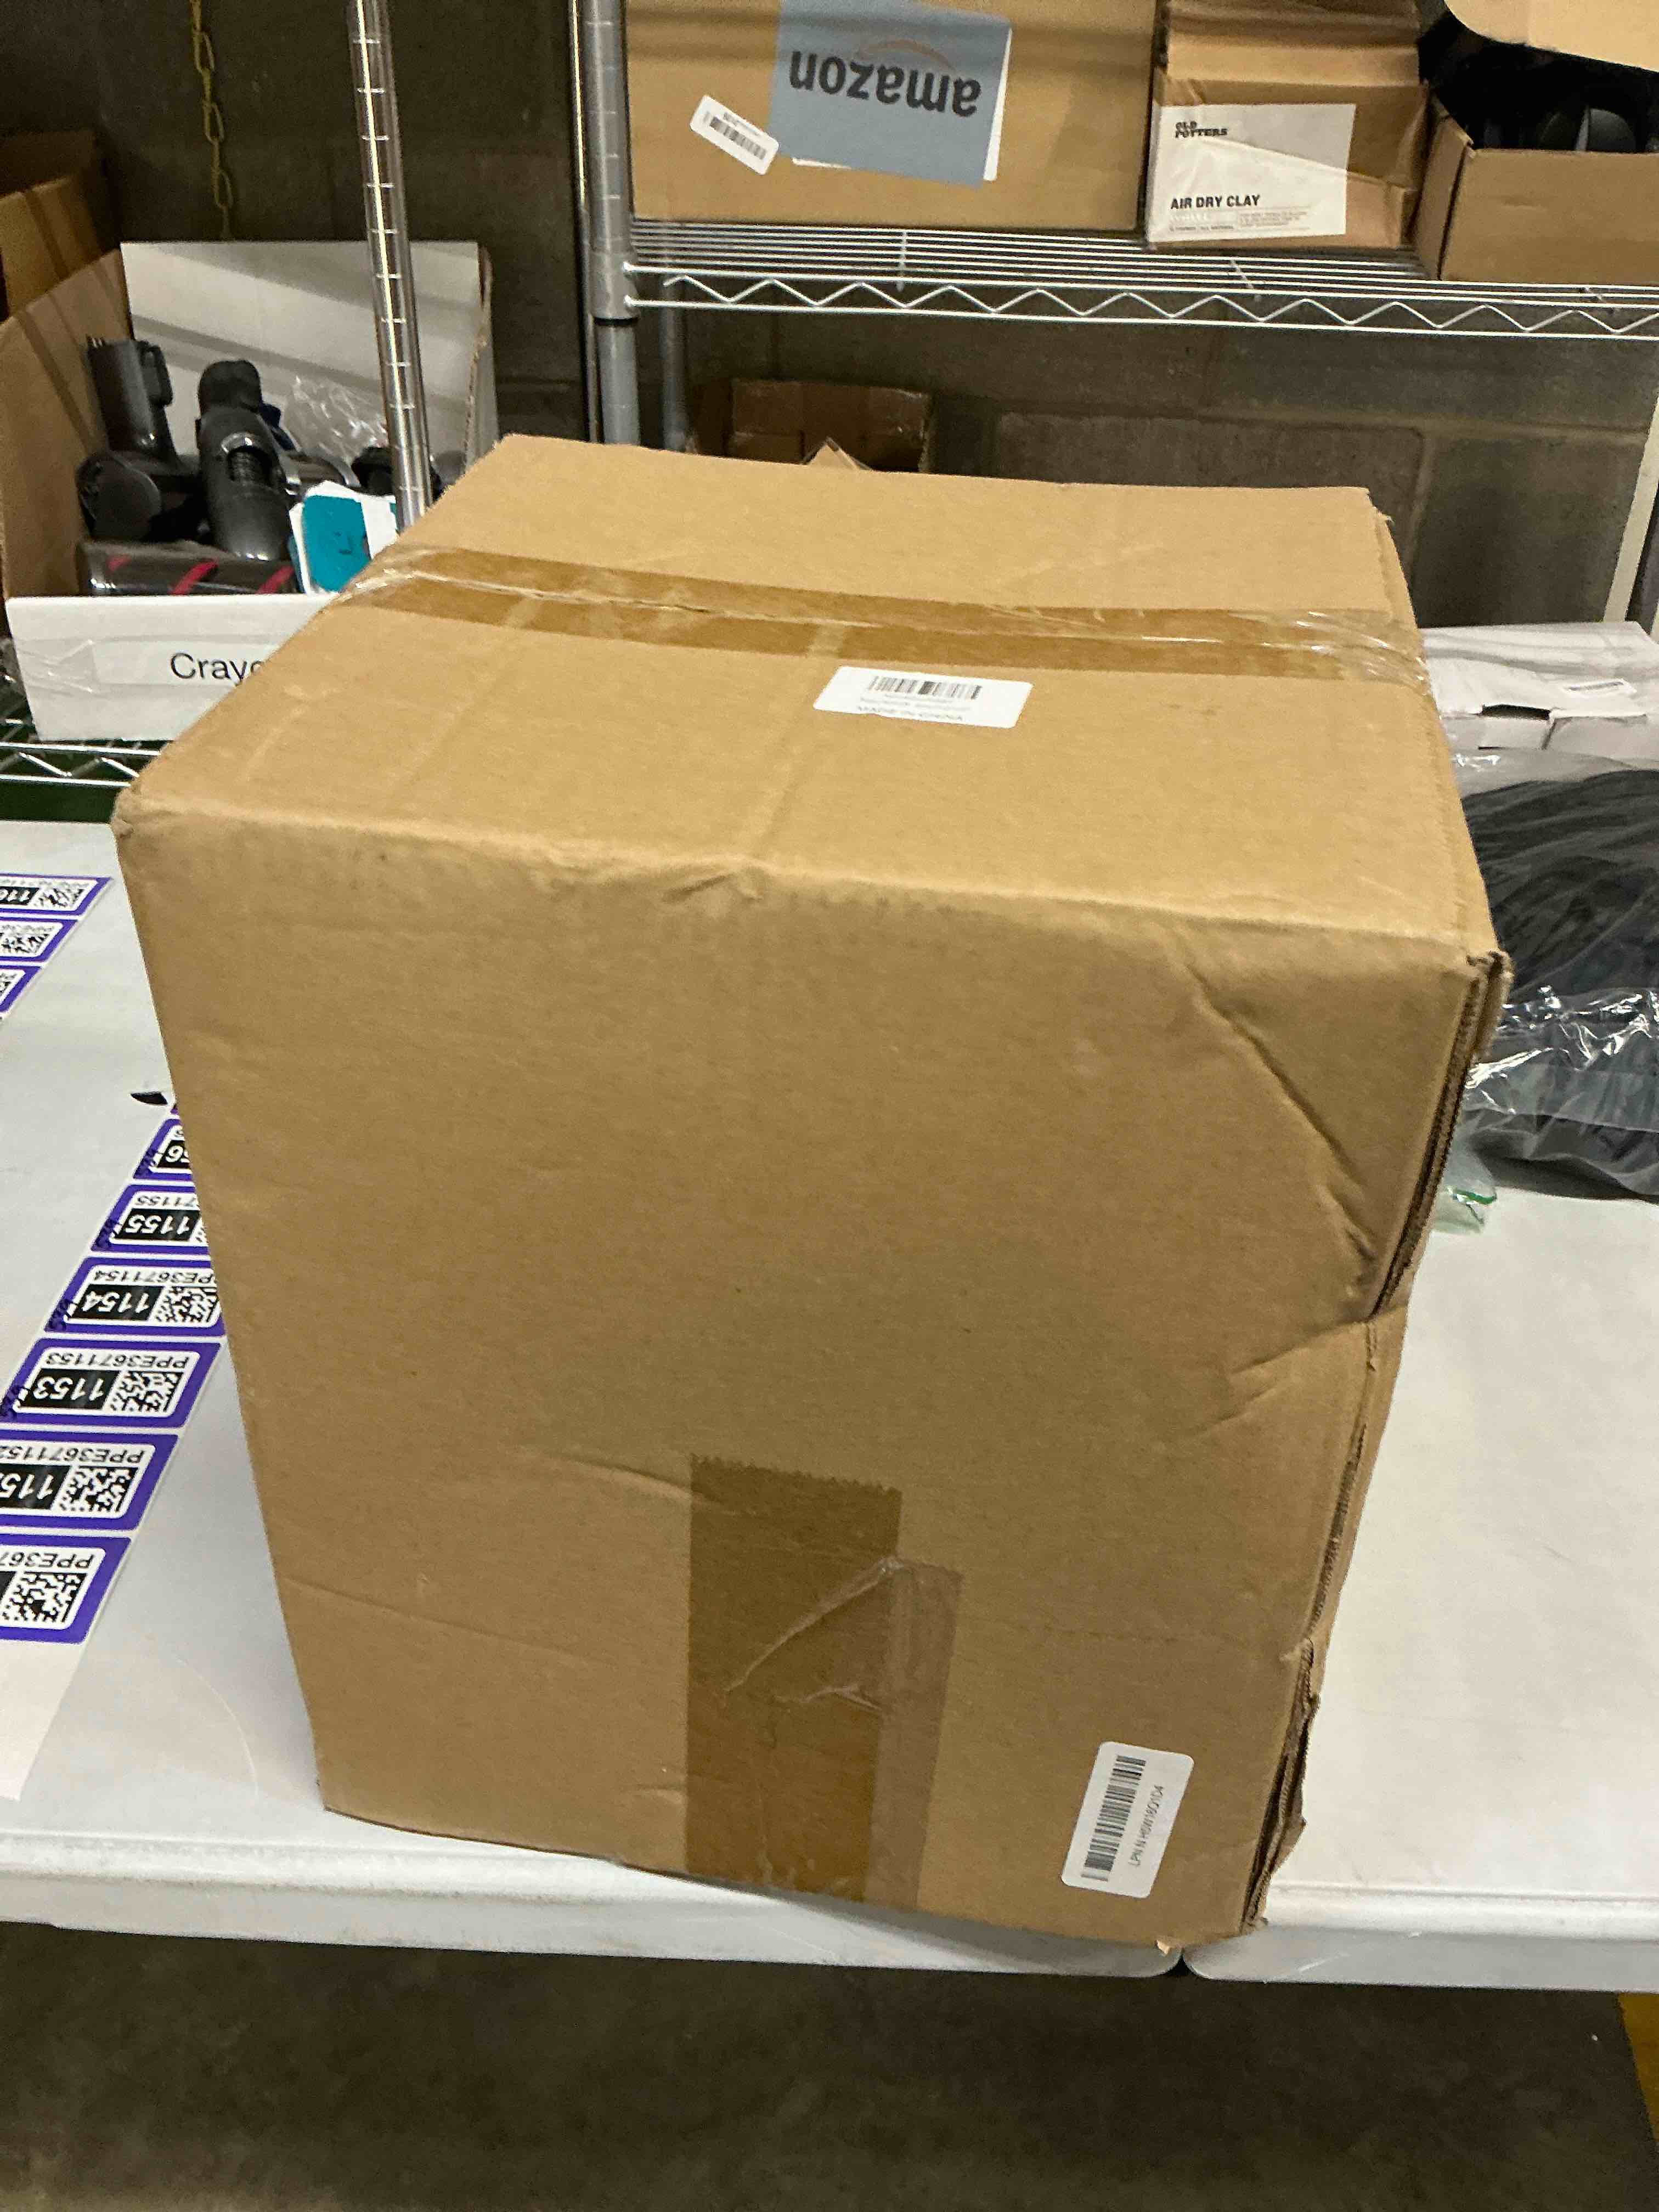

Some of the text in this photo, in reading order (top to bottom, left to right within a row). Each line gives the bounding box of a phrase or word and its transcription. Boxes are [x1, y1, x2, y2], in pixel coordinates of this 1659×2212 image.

[789, 50, 981, 117] amazon
[1171, 194, 1261, 210] AIR DRY CLAY
[136, 1196, 196, 1207] 71155
[125, 1214, 191, 1235] 1155
[94, 1270, 214, 1284] PE3671154
[82, 1291, 150, 1313] 1154
[46, 1352, 189, 1368] PPE3671153
[32, 1376, 104, 1401] 1153
[0, 1472, 54, 1499] 115
